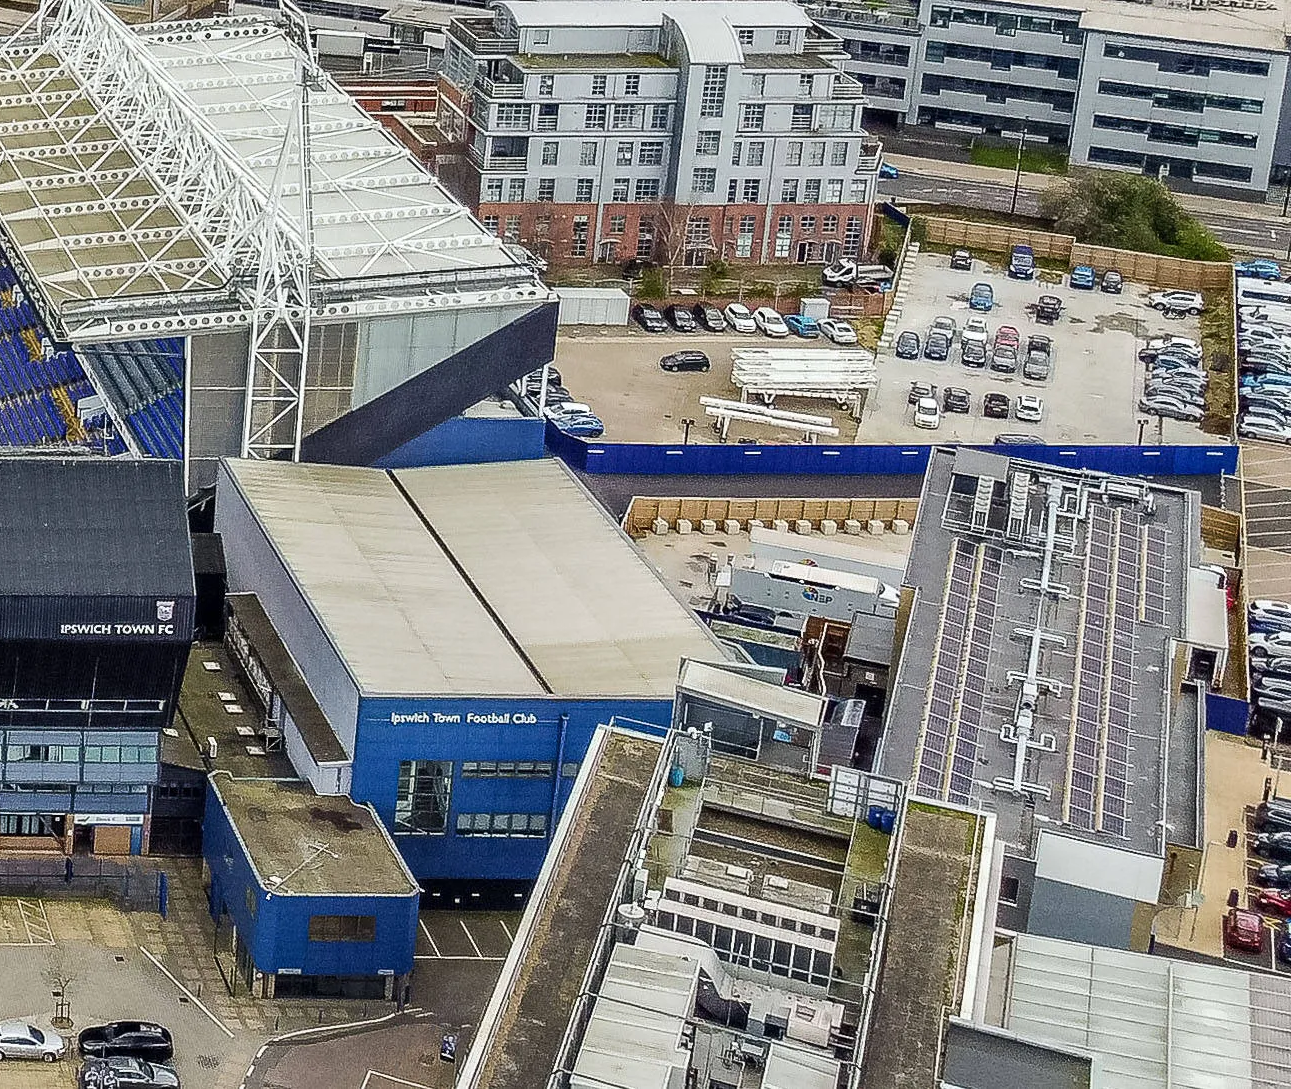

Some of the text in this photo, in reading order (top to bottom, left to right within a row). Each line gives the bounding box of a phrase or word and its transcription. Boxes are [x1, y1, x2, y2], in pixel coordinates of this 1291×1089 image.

[60, 624, 174, 635] IPSWICH TOWN FC
[391, 712, 537, 724] Ipswich Town Football Club
